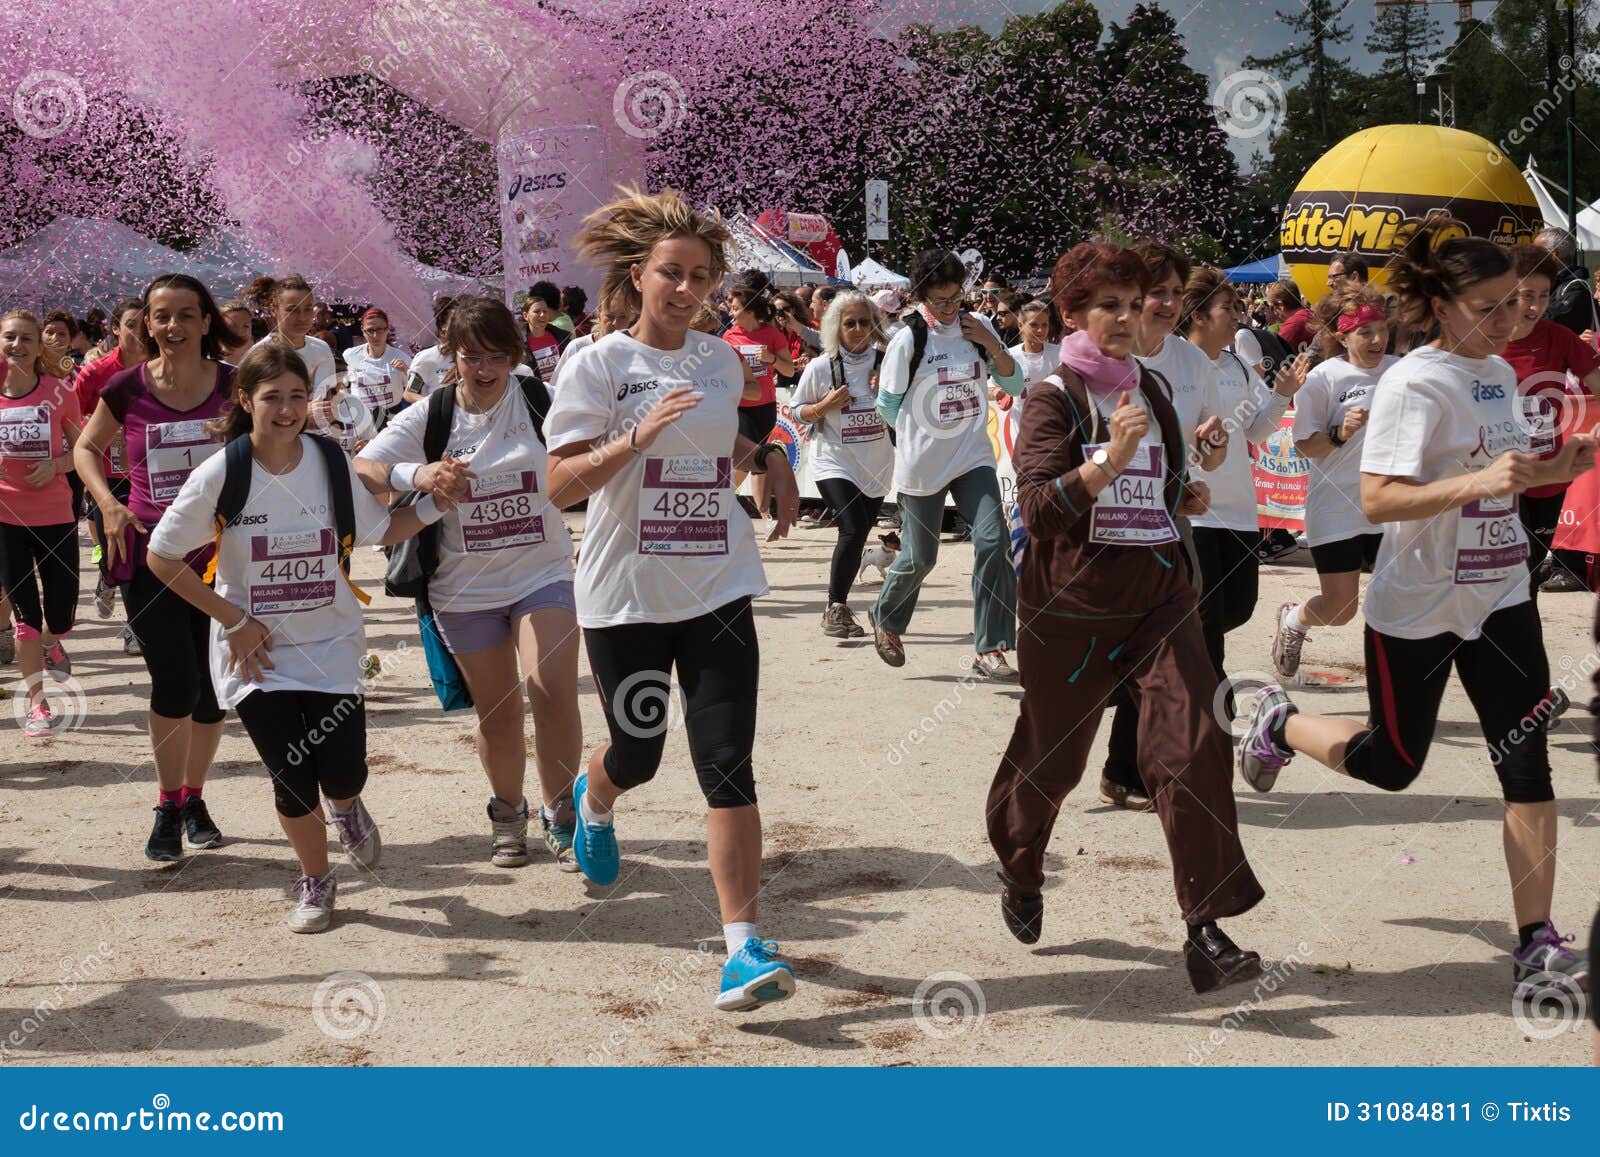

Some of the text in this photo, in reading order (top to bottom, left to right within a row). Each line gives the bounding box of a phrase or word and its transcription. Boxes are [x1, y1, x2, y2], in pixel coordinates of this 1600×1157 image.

[523, 173, 566, 193] asics
[1493, 233, 1516, 245] radio
[519, 261, 561, 277] TIMEX
[630, 379, 660, 394] asics
[692, 377, 728, 389] AVON
[1347, 388, 1367, 399] asics
[1481, 383, 1506, 399] asics
[848, 413, 881, 427] 3938
[0, 424, 41, 440] 3163
[504, 422, 528, 440] AVO
[183, 448, 192, 467] 1
[452, 446, 477, 458] asics
[153, 474, 181, 483] MILANO
[1109, 478, 1156, 506] 1644
[301, 505, 328, 516] AVO
[470, 495, 531, 523] 4368
[653, 491, 720, 518] 4825
[242, 514, 269, 526] asics
[1096, 512, 1129, 521] MILANO
[465, 528, 494, 536] MILANO
[643, 525, 677, 534] MILANO
[684, 525, 693, 533] 19
[695, 524, 726, 533] MAGGIO
[1475, 518, 1517, 547] 1925
[1460, 554, 1491, 562] MILANO
[260, 559, 325, 582] 4404
[253, 588, 284, 597] MILANO
[300, 585, 334, 594] MAGGIO
